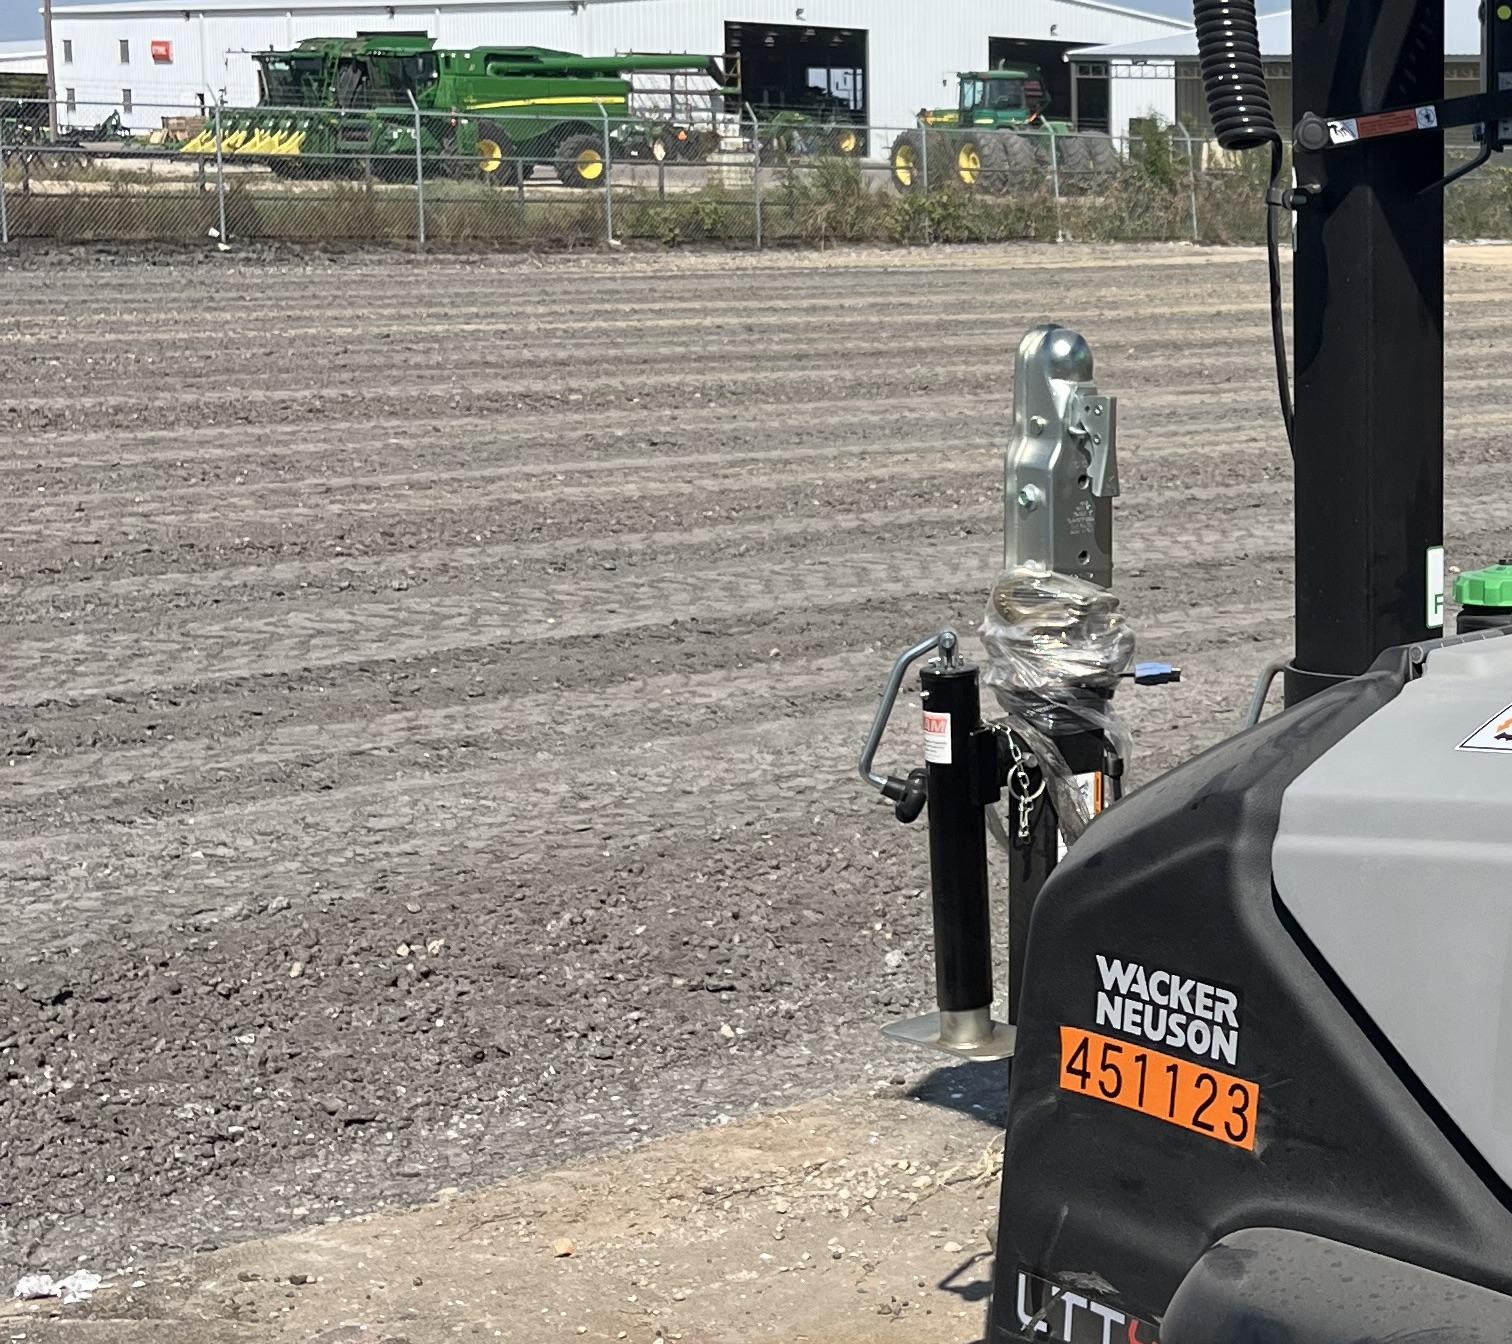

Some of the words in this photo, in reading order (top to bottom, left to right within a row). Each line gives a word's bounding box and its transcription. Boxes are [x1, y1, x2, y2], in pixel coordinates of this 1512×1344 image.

[1095, 953, 1239, 1028] WACKER
[1095, 991, 1239, 1067] NEUSON
[1065, 1036, 1250, 1143] 451123
